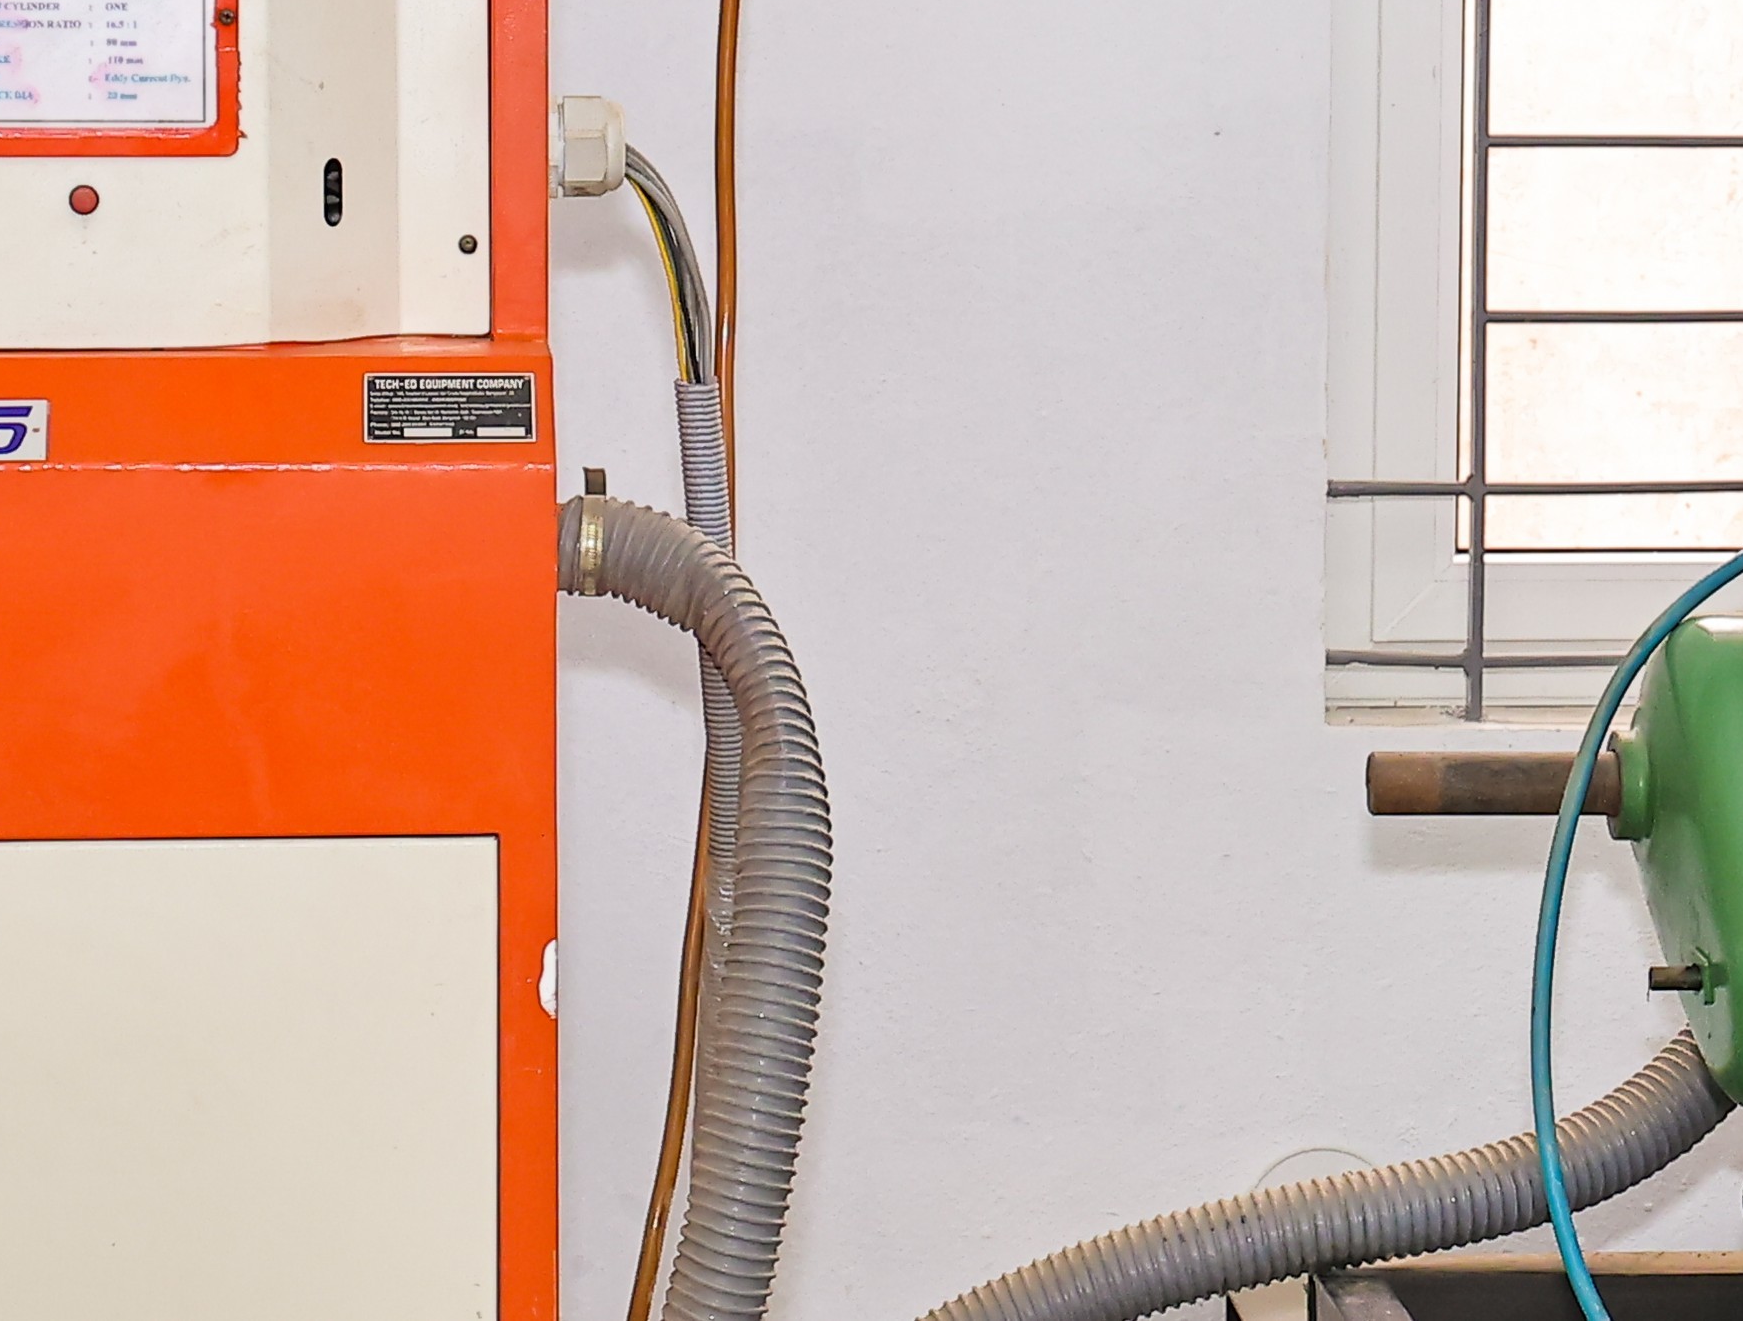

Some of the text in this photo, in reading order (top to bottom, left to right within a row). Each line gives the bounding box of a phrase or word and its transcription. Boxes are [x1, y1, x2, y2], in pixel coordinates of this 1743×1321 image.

[4, 2, 60, 11] CYLINDER
[105, 2, 128, 11] ONE
[47, 20, 81, 29] RATIO
[105, 73, 128, 84] Eddy
[131, 73, 167, 82] Current
[374, 379, 524, 389] TECH-ED EQUIPMENT COMPANY
